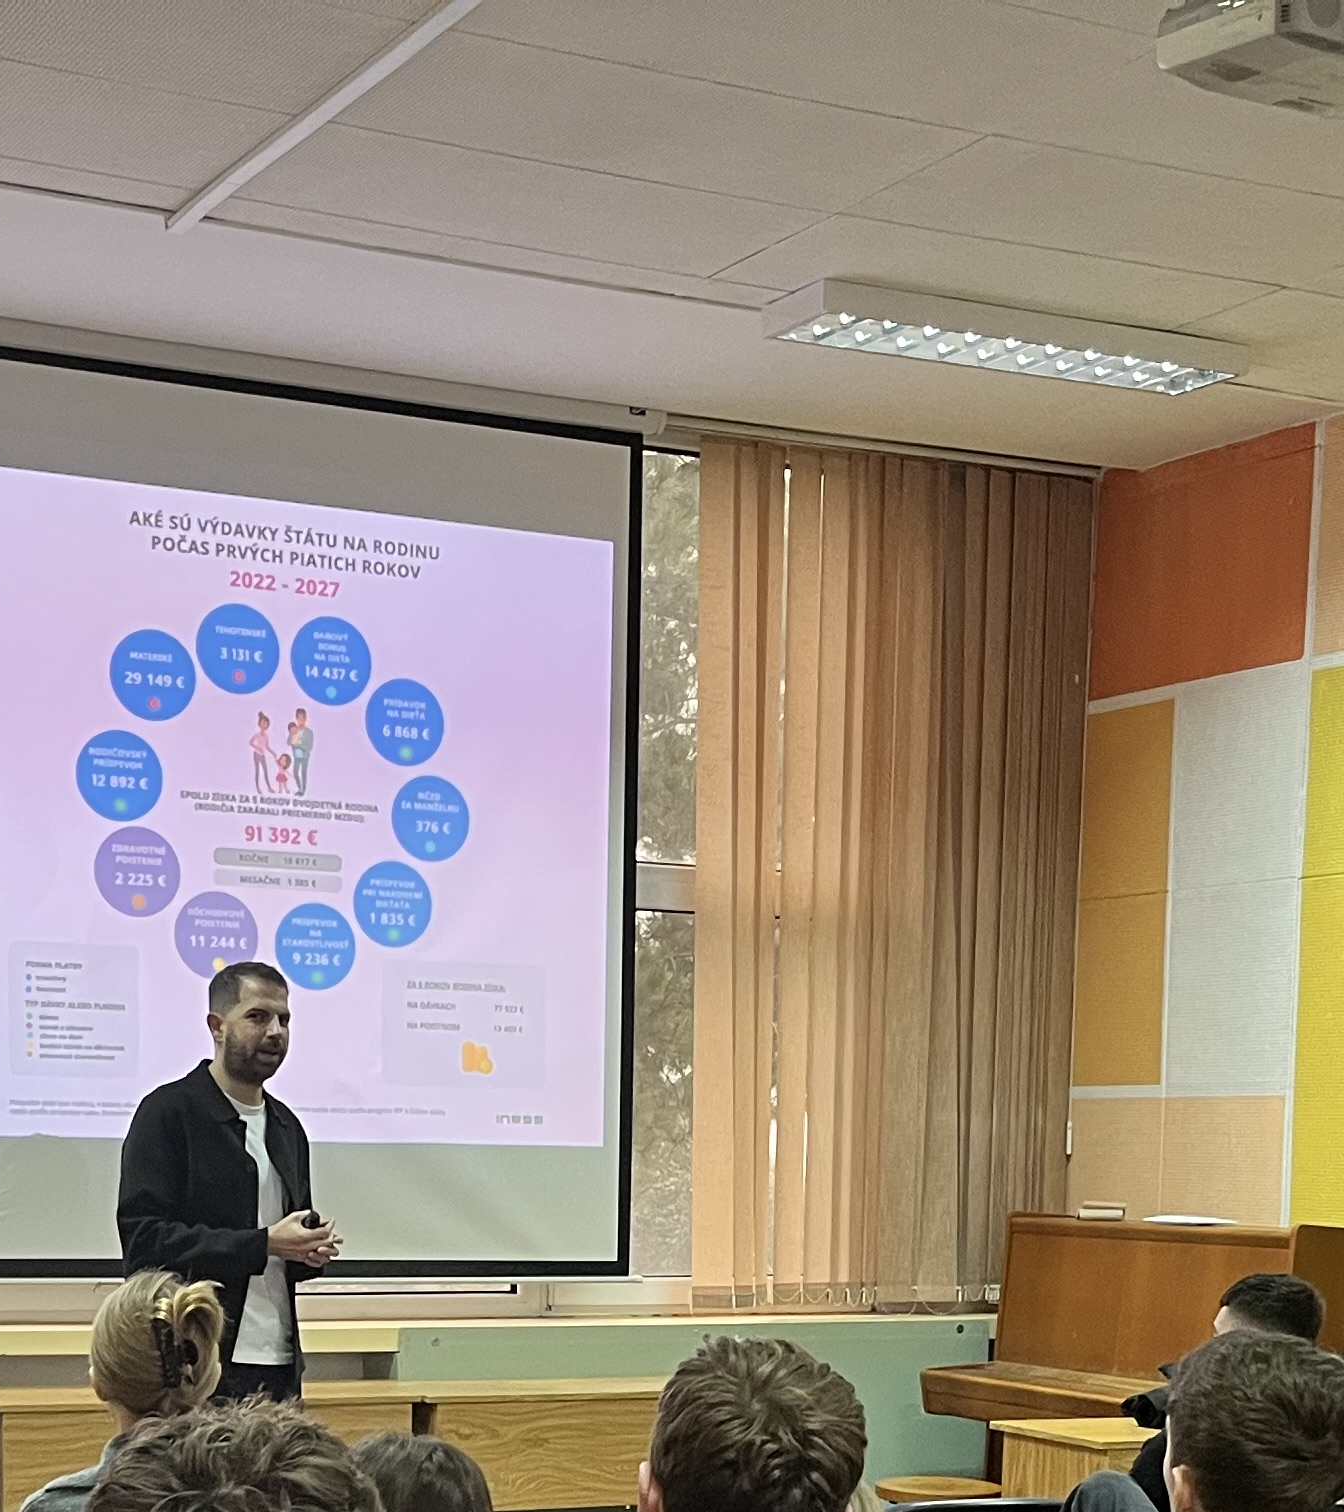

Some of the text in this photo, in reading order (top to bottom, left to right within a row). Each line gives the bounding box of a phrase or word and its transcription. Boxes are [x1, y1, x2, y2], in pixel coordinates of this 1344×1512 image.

[129, 509, 440, 560] AKÉ SÚ VÝDAVKY ŠTÁTU NA RODINU
[152, 534, 421, 579] POČAS PRVÝCH PIATICH ROKOV
[230, 570, 276, 592] 2022
[295, 577, 340, 598] 2027
[220, 647, 263, 663] 3 131 €
[124, 671, 185, 689] 29 149 €
[305, 665, 358, 682] 14 437 €
[383, 725, 391, 737] 6
[394, 725, 418, 740] 868
[92, 774, 149, 790] 12 892 €
[244, 825, 318, 846] 91 392 €
[415, 821, 451, 835] 376 €
[115, 871, 167, 887] 2 225 €
[380, 913, 404, 926] 835
[190, 934, 247, 950] 11 244 €
[292, 952, 301, 965] 9
[305, 953, 329, 966] 236
